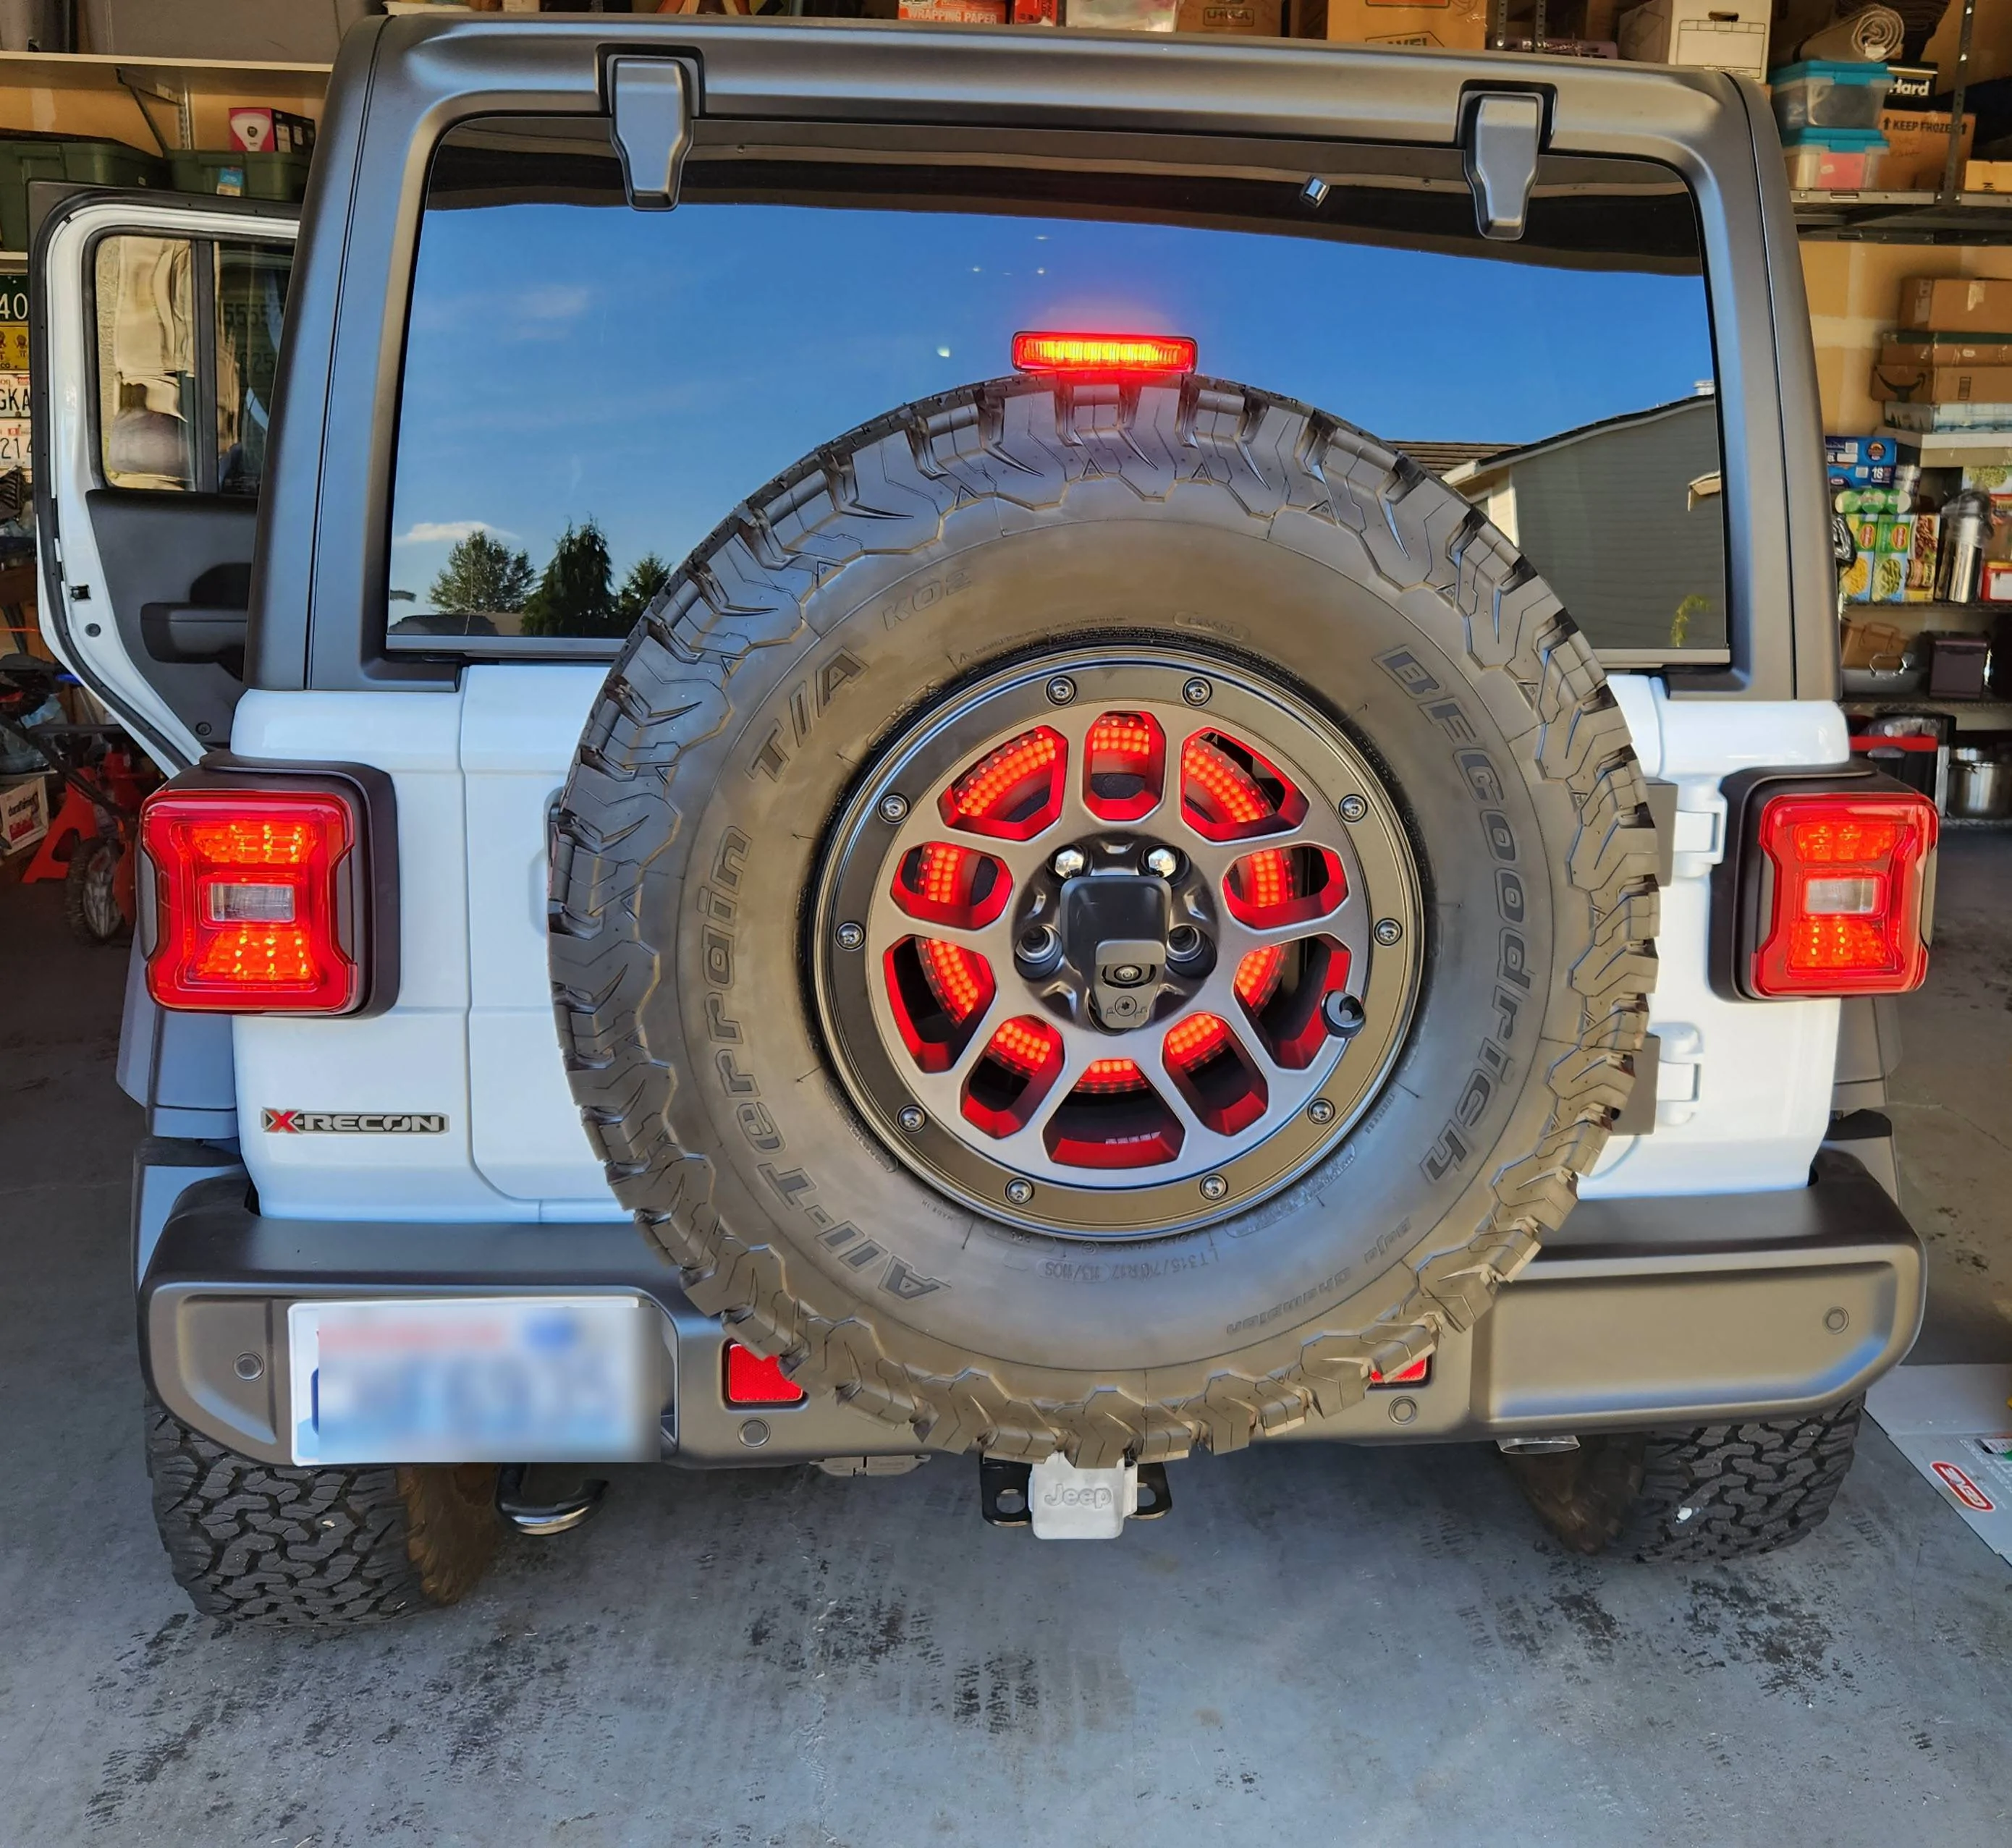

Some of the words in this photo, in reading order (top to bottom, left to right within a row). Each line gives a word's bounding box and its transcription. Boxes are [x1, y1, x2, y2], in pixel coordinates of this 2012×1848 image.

[908, 9, 961, 22] WRAPPING
[964, 12, 997, 24] PAPER
[1893, 119, 1918, 131] KEEP
[1920, 122, 1952, 133] FROZE
[745, 645, 869, 783] T/A
[697, 826, 951, 1302] All-Terrain
[263, 1108, 440, 1134] X-RECON
[1044, 1483, 1112, 1509] Jeep
